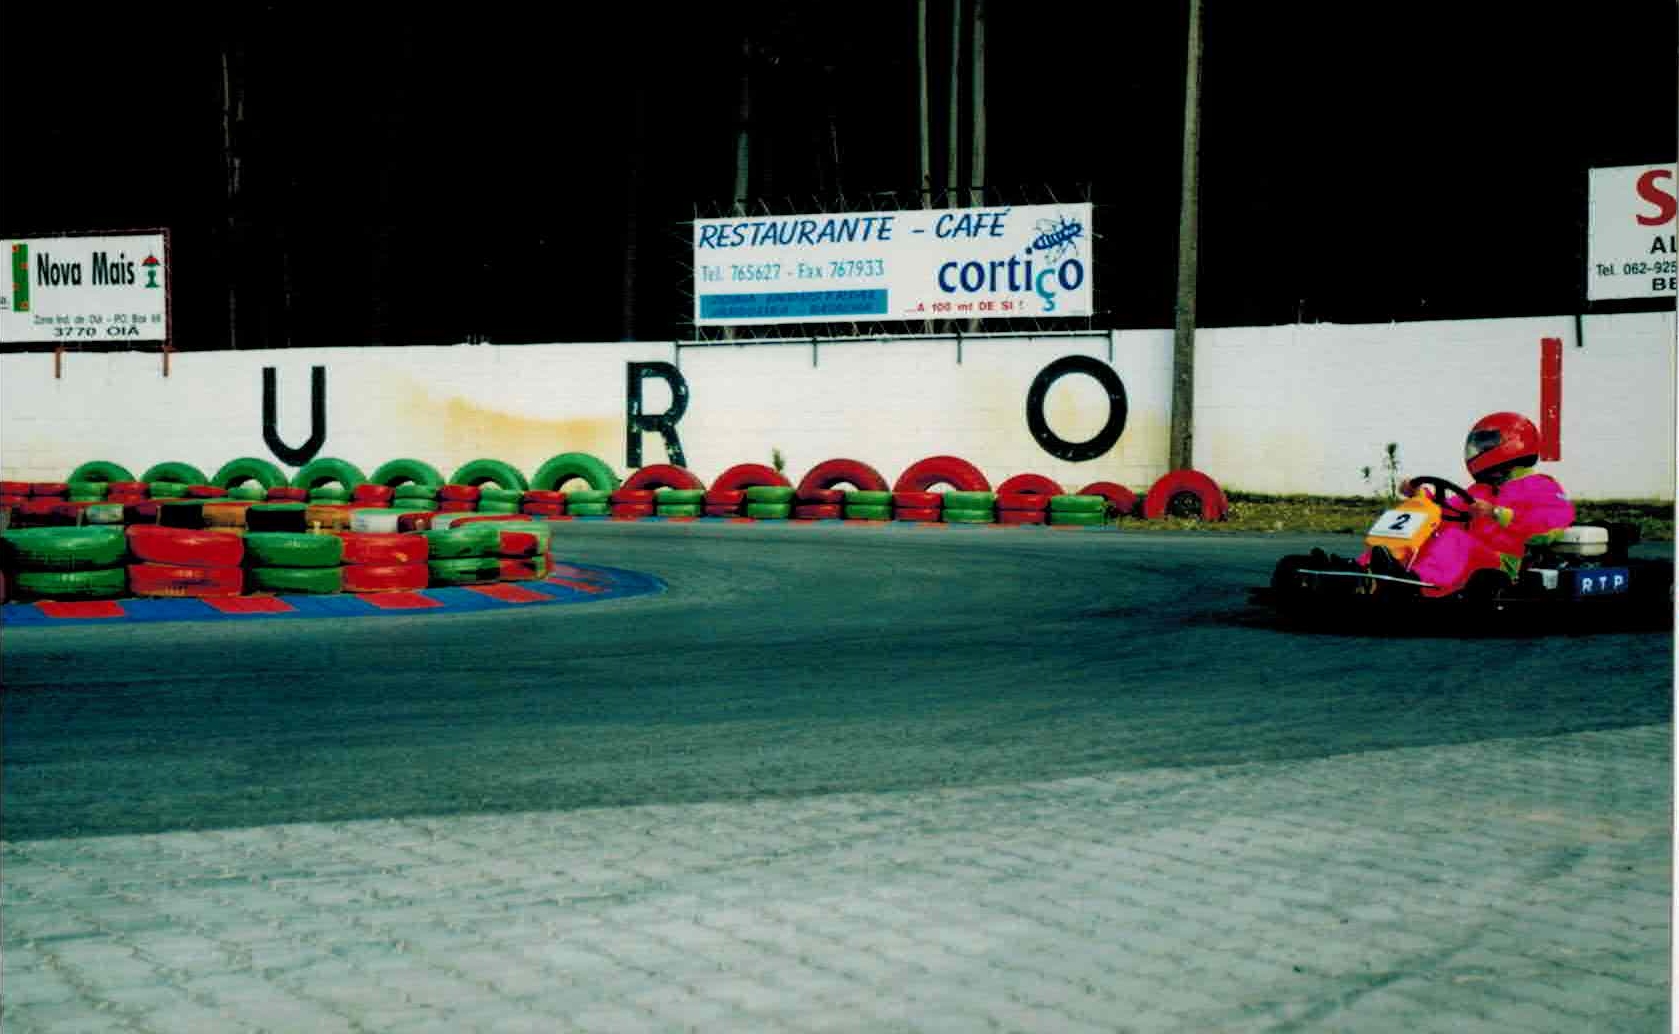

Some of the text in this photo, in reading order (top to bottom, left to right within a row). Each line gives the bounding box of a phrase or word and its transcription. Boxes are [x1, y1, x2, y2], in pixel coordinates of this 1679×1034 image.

[699, 216, 894, 249] RESTAURANTE
[935, 207, 1012, 239] CAFÉ
[37, 251, 135, 286] Nova Mais
[828, 259, 885, 277] 767933
[938, 247, 1084, 312] cortiço
[979, 301, 995, 311] DE
[1388, 513, 1412, 530] 2
